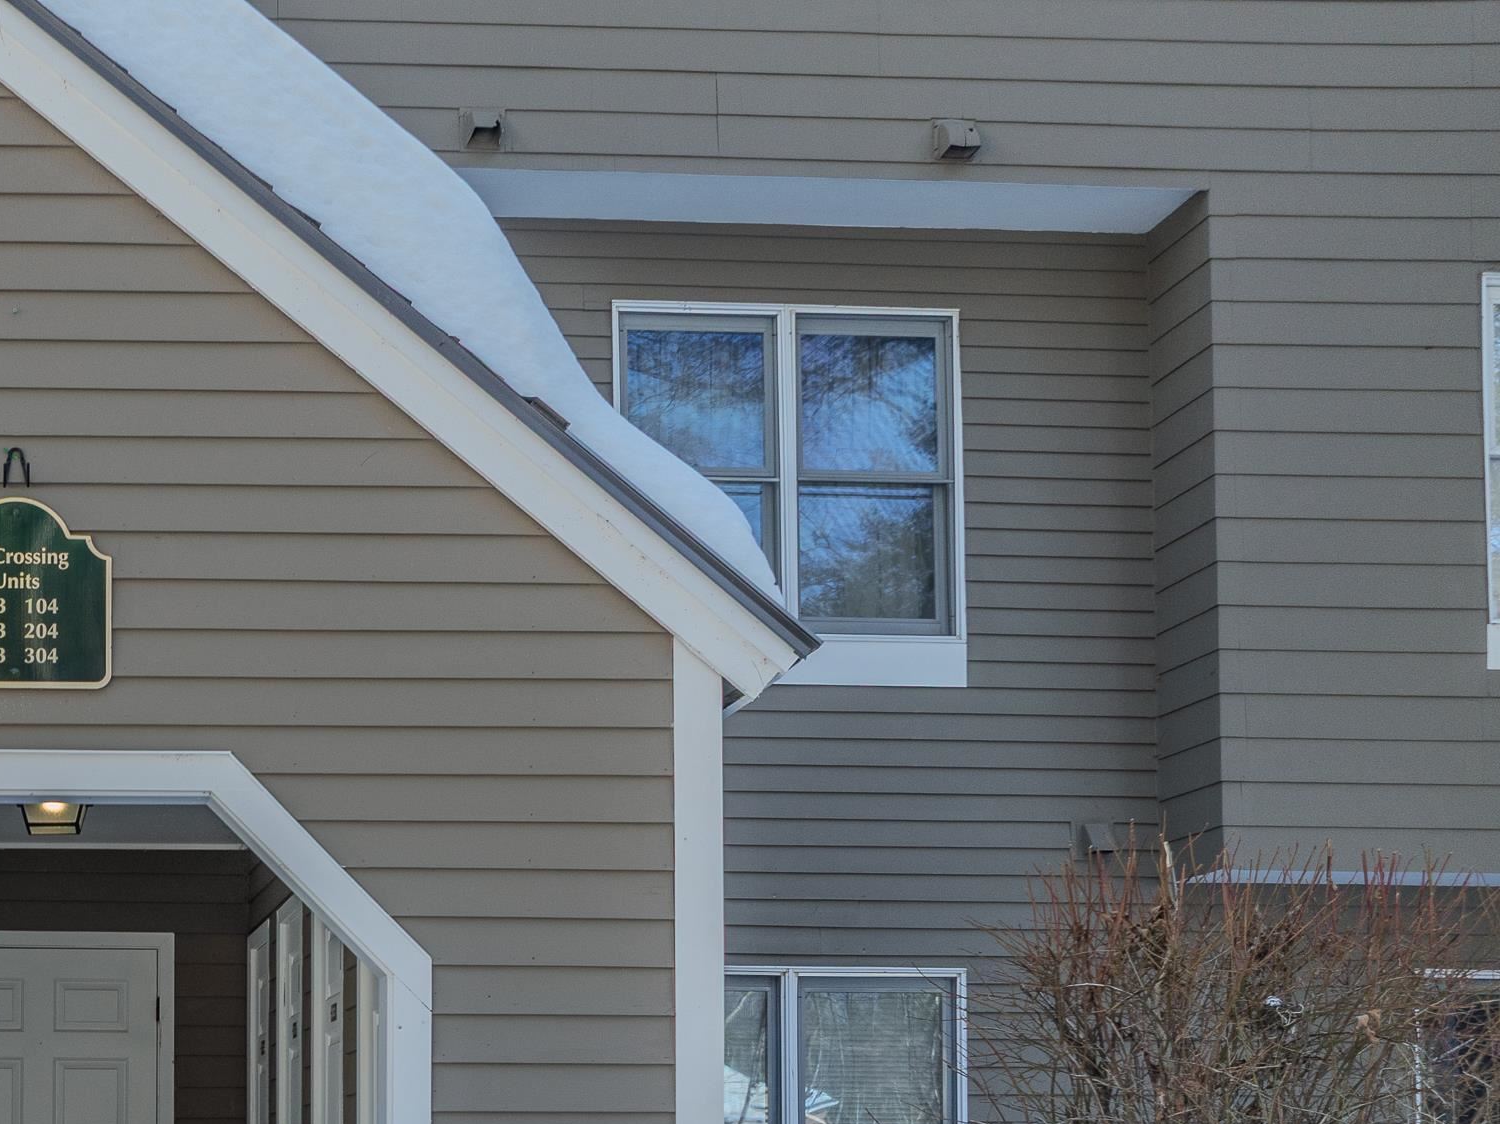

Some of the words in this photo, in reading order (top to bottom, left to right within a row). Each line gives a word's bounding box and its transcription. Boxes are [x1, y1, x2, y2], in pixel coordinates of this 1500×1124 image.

[25, 598, 58, 614] 104
[24, 622, 58, 639] 204
[24, 647, 58, 663] 304
